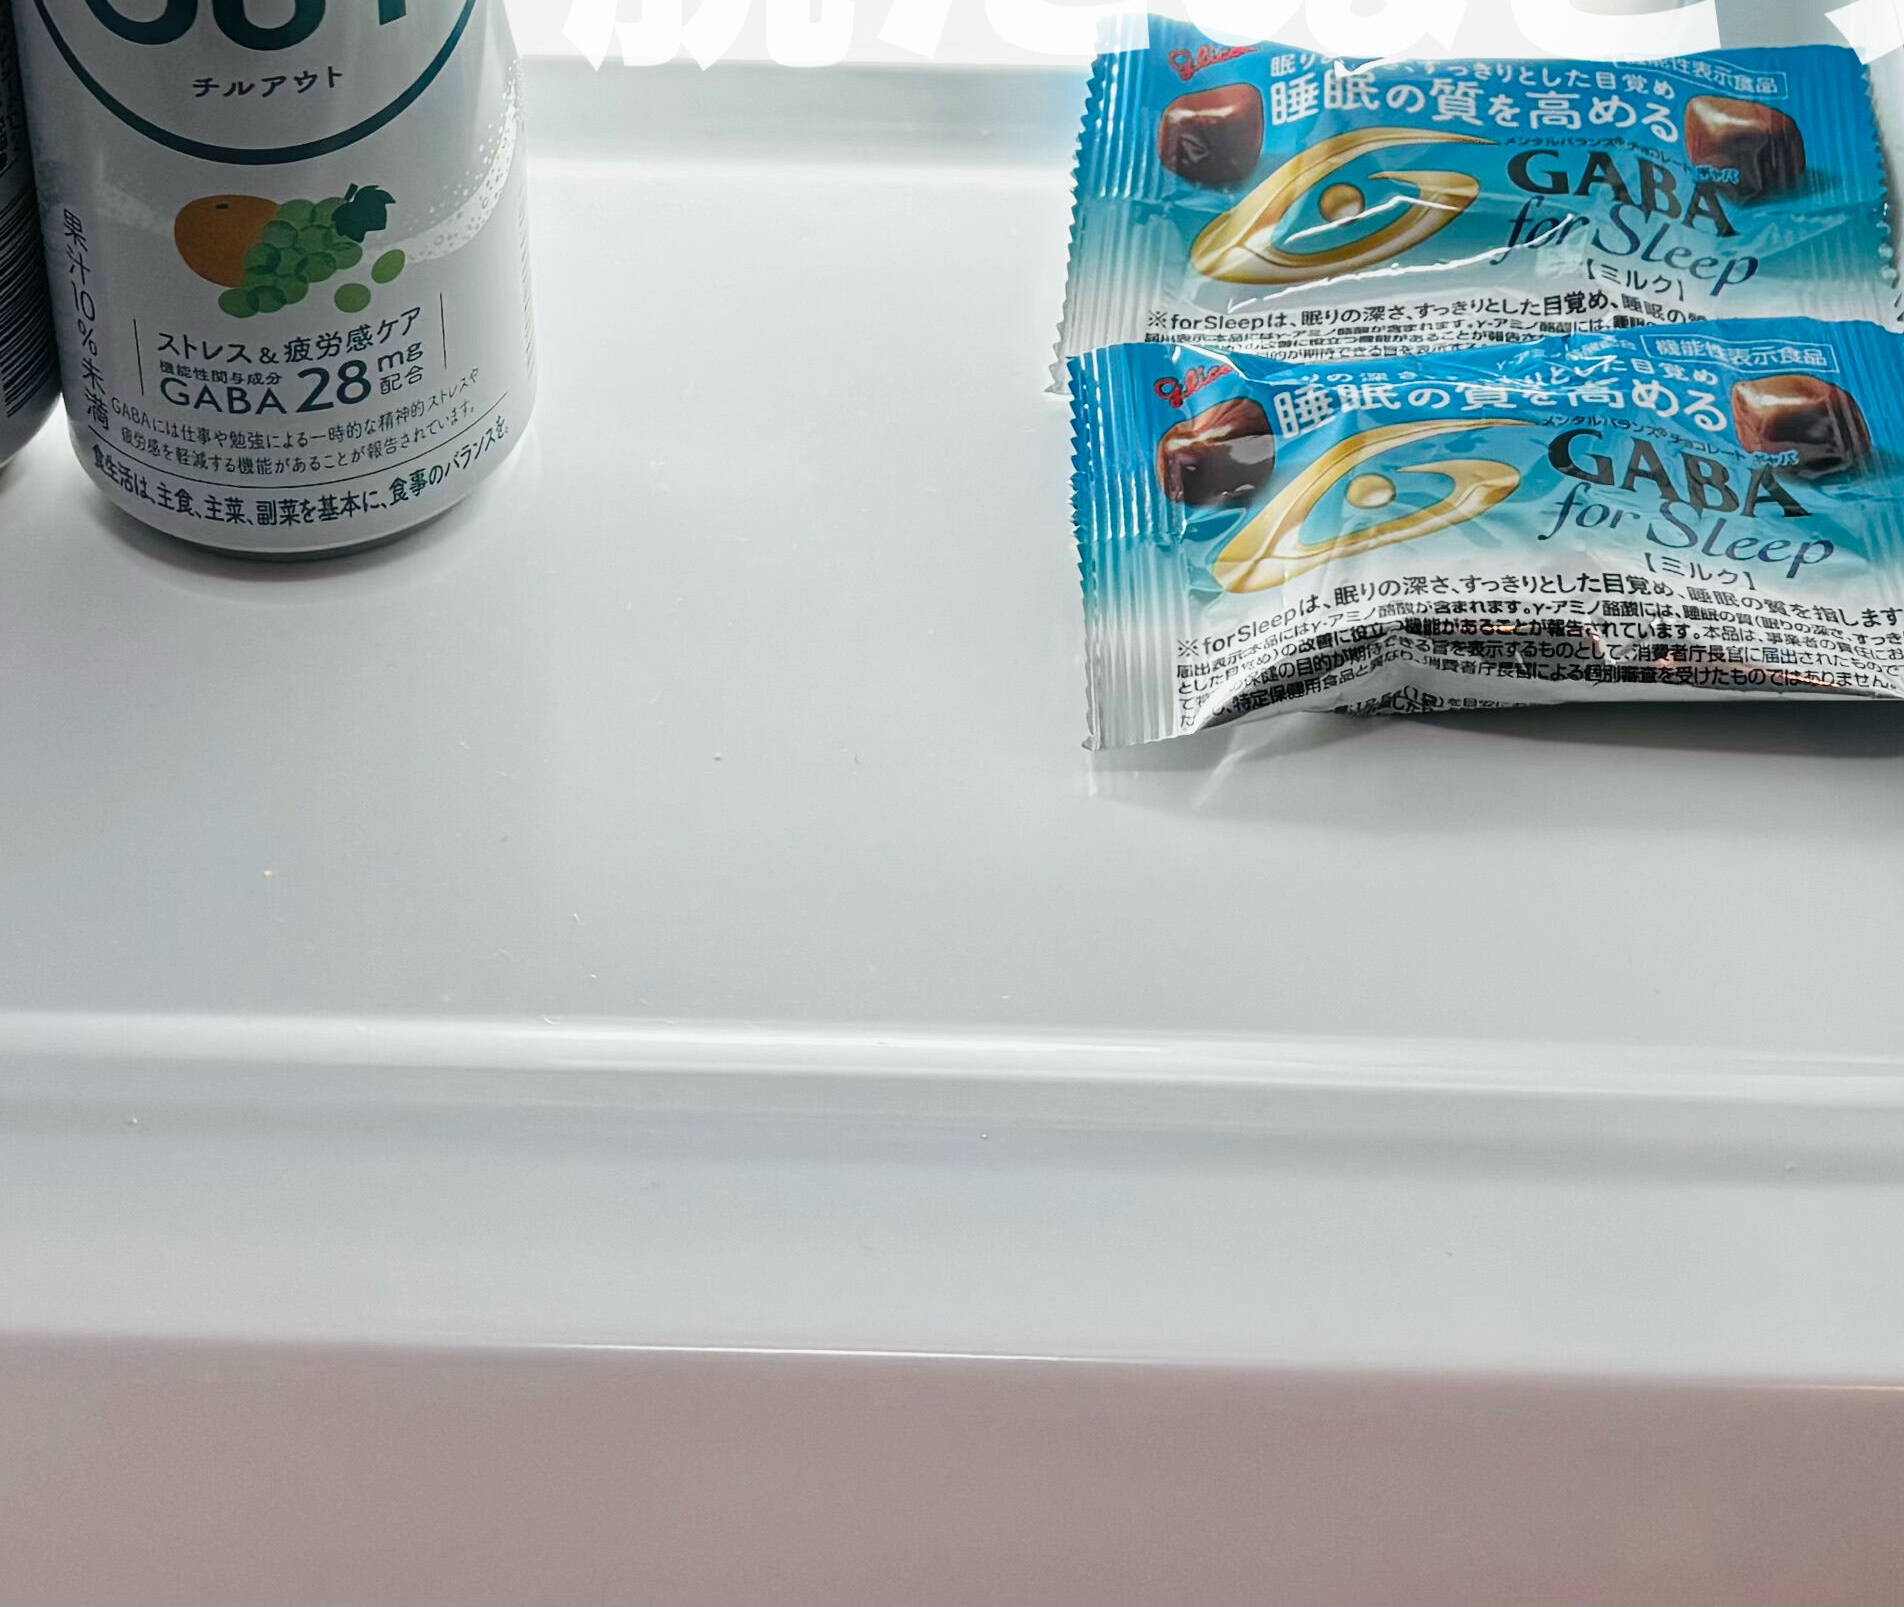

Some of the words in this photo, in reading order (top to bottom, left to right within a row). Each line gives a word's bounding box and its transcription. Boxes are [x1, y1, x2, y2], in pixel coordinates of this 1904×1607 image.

[191, 65, 343, 99] チルアウト
[1270, 70, 1680, 144] 睡眠の質を高める
[1506, 148, 1741, 239] GABA
[1585, 258, 1685, 302] 【ミルク】
[1590, 200, 1761, 299] Sleep
[62, 208, 110, 431] 果汁10%未満
[1655, 338, 1829, 367] 機能性表示食品
[110, 367, 480, 451] GABAには仕事や勉強による一時的な精神的ストレスや
[159, 360, 283, 386] 機能性関与成分
[159, 378, 288, 416] GABA
[295, 359, 373, 413] 28
[377, 342, 425, 373] mg
[379, 366, 425, 396] 配合
[91, 415, 510, 527] 食生活は、主食、主菜、副菜を基本に、食事のバランスを。
[120, 399, 476, 477] 疲労感を軽減する機能があることが報告されています。
[1546, 427, 1811, 522] GABA
[1538, 482, 1648, 541] for
[1647, 498, 1836, 580] Sleep
[1644, 548, 1756, 591] 【ミルク】
